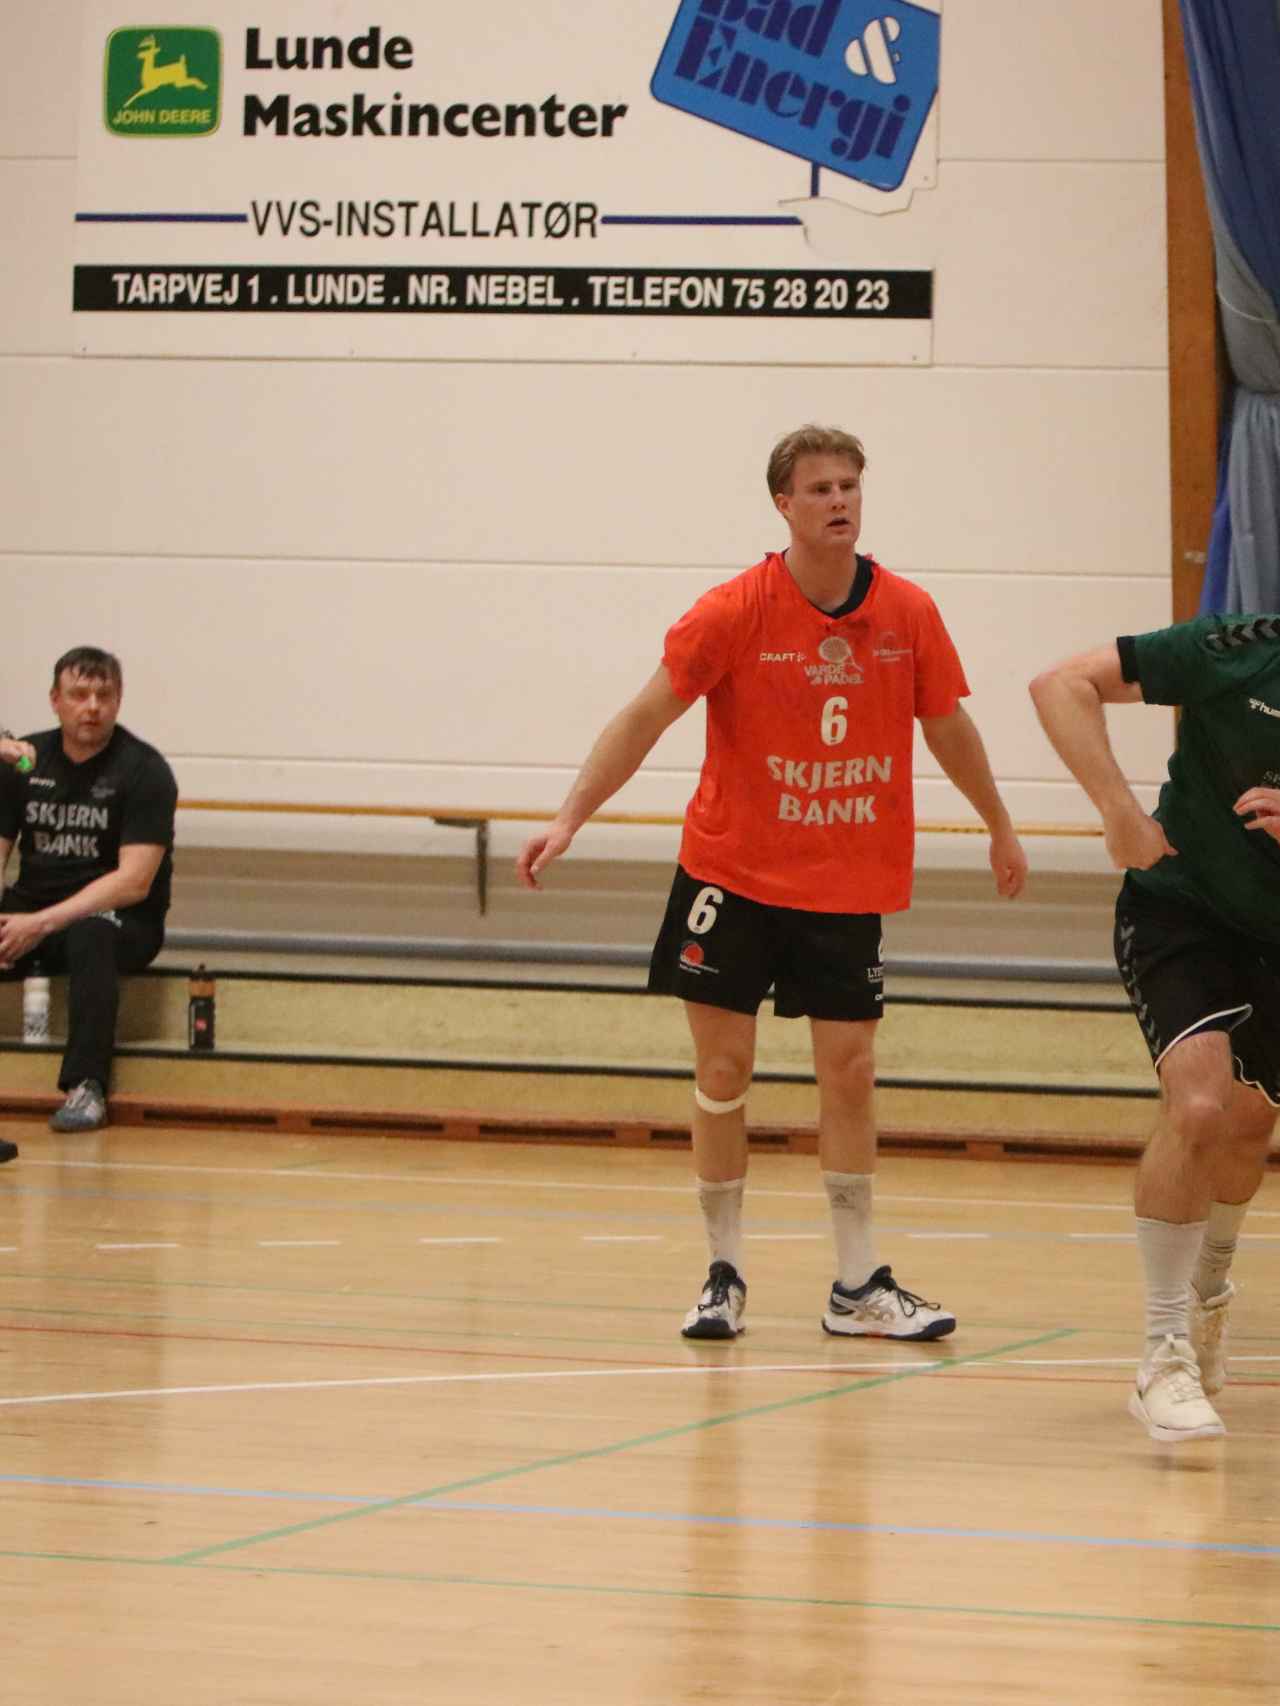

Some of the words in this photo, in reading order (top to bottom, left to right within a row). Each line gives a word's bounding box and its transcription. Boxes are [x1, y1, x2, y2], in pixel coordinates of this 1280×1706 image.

[245, 26, 413, 69] Lunde
[845, 16, 900, 84] &
[674, 15, 910, 161] Energi
[113, 109, 154, 124] JOHN
[159, 109, 211, 124] DEERE
[243, 94, 628, 137] Maskincenter
[250, 200, 598, 239] VVS-INSTALLATØR
[112, 272, 239, 305] TARPVEJ
[246, 273, 260, 304] 1
[286, 273, 385, 305] LUNDE
[408, 274, 457, 306] NR.
[466, 275, 564, 307] NEBEL
[588, 275, 723, 307] TELEFON
[732, 277, 766, 308] 75
[773, 277, 808, 309] 28
[814, 278, 848, 310] 20
[856, 278, 889, 310] 23
[760, 652, 796, 662] CRAFT
[820, 696, 848, 747] 6
[768, 756, 892, 793] SKJERN
[26, 801, 109, 831] SKJERN
[777, 793, 877, 826] BANK
[33, 831, 100, 857] BANK
[687, 886, 724, 935] 6
